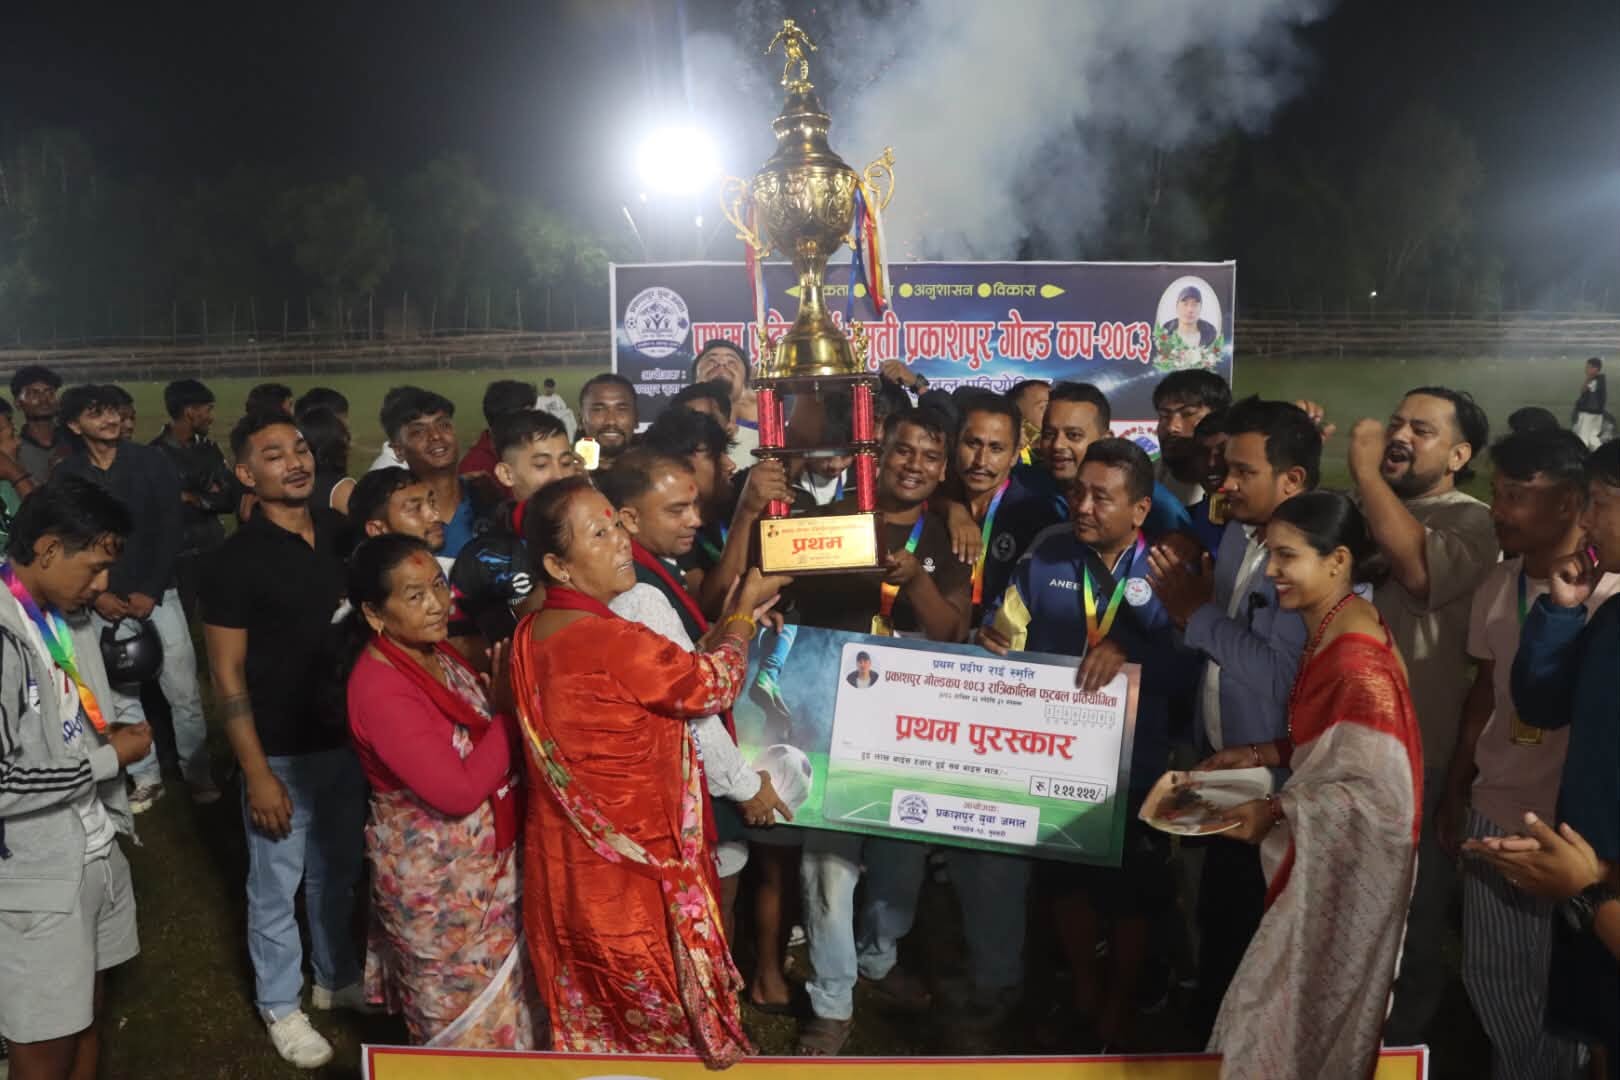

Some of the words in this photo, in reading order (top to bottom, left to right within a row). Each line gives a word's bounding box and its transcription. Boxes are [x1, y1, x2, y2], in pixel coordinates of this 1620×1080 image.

[822, 284, 848, 297] कता
[913, 283, 973, 300] अनुशासन
[993, 282, 1036, 297] विकास
[904, 320, 993, 370] प्रकाशपुर
[998, 308, 1053, 361] गोल्ड
[1056, 320, 1152, 364] कप-२०८३
[792, 536, 843, 555] प्रथम
[933, 659, 956, 669] प्रथम
[960, 661, 983, 674] प्रदीप
[885, 670, 921, 687] प्रकाशपुर
[963, 680, 985, 692] २०८३
[896, 714, 960, 745] प्रथम
[969, 723, 1077, 760] पुरस्कार
[935, 808, 975, 823] प्रकाशपुर
[1000, 817, 1027, 829] जमात
